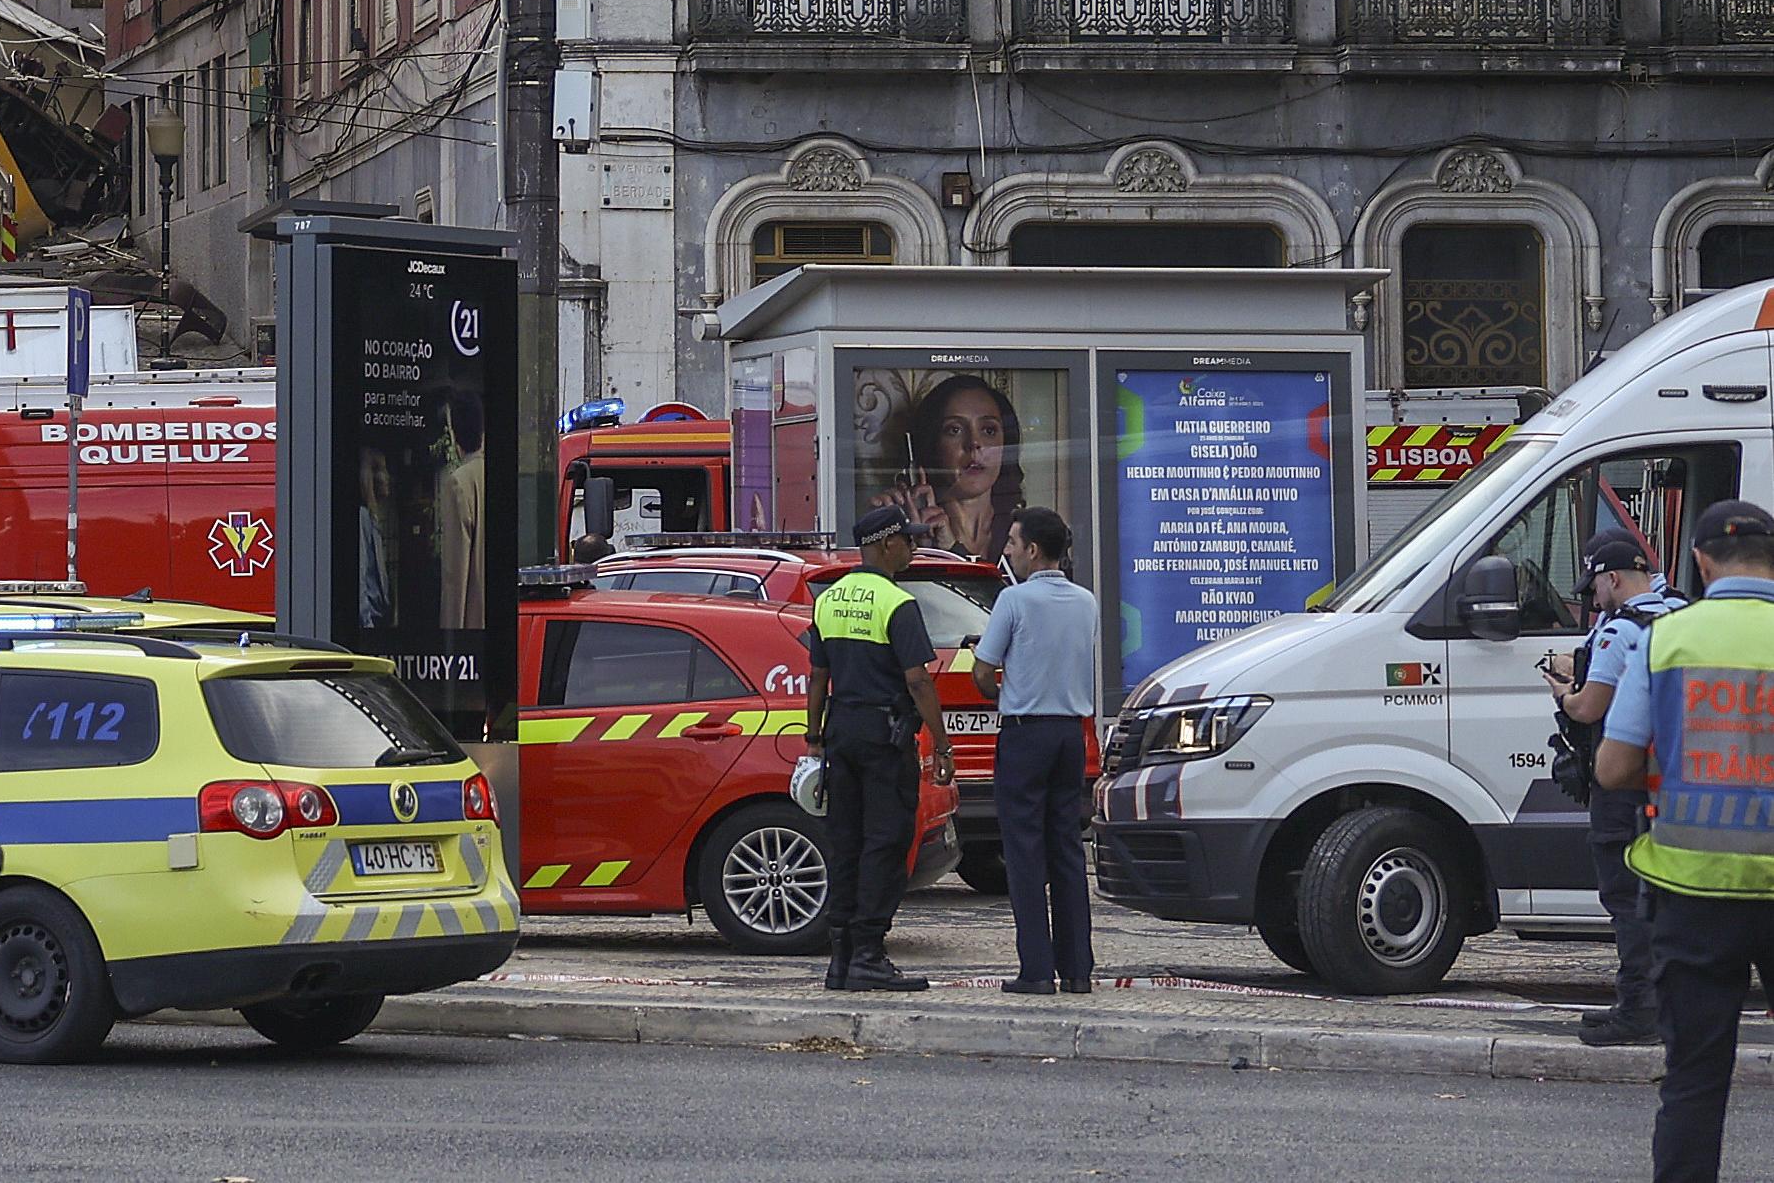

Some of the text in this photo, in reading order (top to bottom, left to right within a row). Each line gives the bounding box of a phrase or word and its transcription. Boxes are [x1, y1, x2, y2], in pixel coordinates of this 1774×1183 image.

[601, 185, 672, 198] LIBERDADE
[407, 260, 446, 275] JCDecaux
[364, 339, 432, 362] NO CORAÇÃO
[364, 363, 420, 380] DO BAIRRO
[364, 390, 421, 408] para melhor
[1178, 395, 1226, 407] Alfama
[372, 411, 426, 428] aconselhar.
[1175, 420, 1271, 434] KATIA GUERREIRO
[41, 422, 276, 442] BOMBEIROS
[79, 444, 249, 464] QUELUZ
[1190, 442, 1257, 460] GISELA JOÃO
[1385, 449, 1473, 465] LISBOA
[1127, 467, 1165, 479] HELDER
[1166, 466, 1221, 479] MOUTINHO
[1231, 467, 1264, 479] PEDRO
[1265, 467, 1321, 479] MOUTINHO
[1151, 488, 1169, 500] EM
[1171, 488, 1200, 501] CASA
[1255, 488, 1271, 501] AO
[1272, 488, 1298, 501] VIVO
[1160, 522, 1195, 534] MARIA
[1196, 522, 1210, 534] DA
[1227, 522, 1248, 534] ANA
[1249, 522, 1290, 535] MOURA,
[1153, 538, 1297, 554] ANTÓNIO ZAMBUJO, CAMANÉ,
[1133, 556, 1319, 572] JORGE FERNANDO, JOSÉ MANUEL NETO
[825, 585, 875, 605] POLÍCIA
[1201, 588, 1224, 605] RÃO
[1175, 610, 1217, 623] MARCO
[1383, 694, 1443, 706] PCMM01
[47, 702, 125, 741] 112
[1508, 753, 1546, 768] 1594
